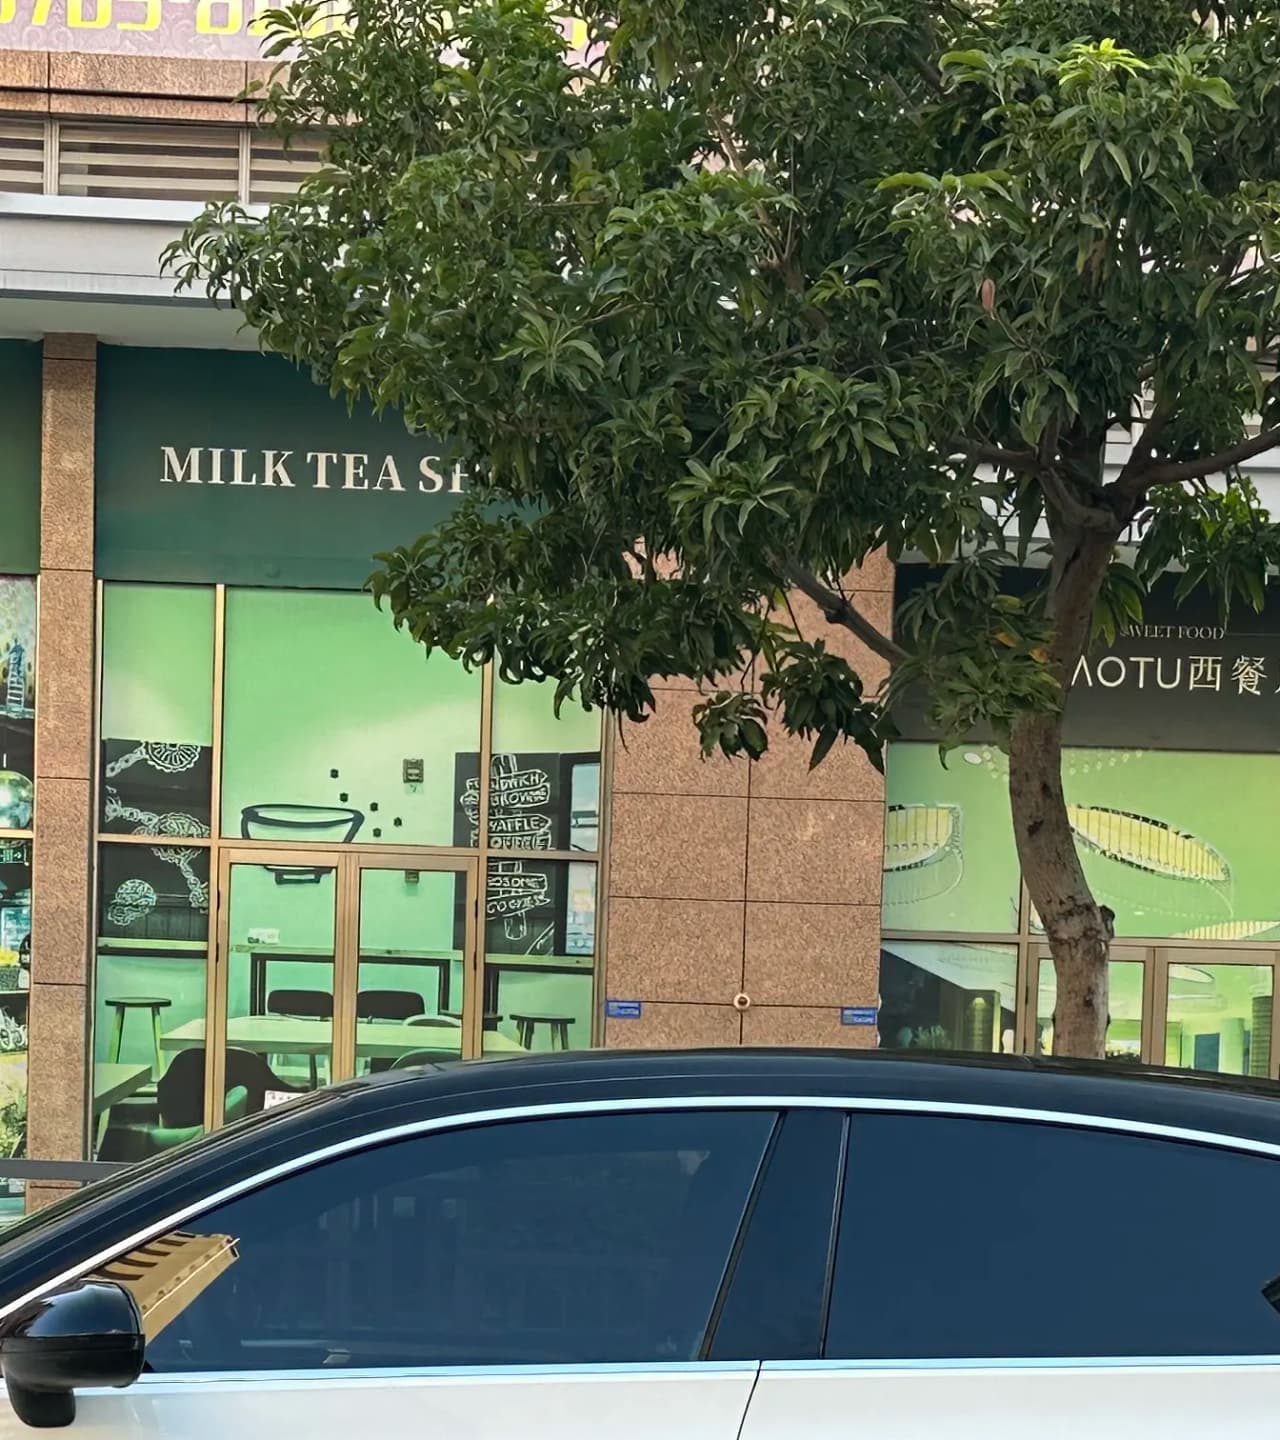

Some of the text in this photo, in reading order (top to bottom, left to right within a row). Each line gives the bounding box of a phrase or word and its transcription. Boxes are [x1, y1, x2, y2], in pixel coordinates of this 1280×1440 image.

[159, 446, 296, 487] MILK
[306, 451, 406, 492] TEA
[1178, 625, 1225, 640] FOOD
